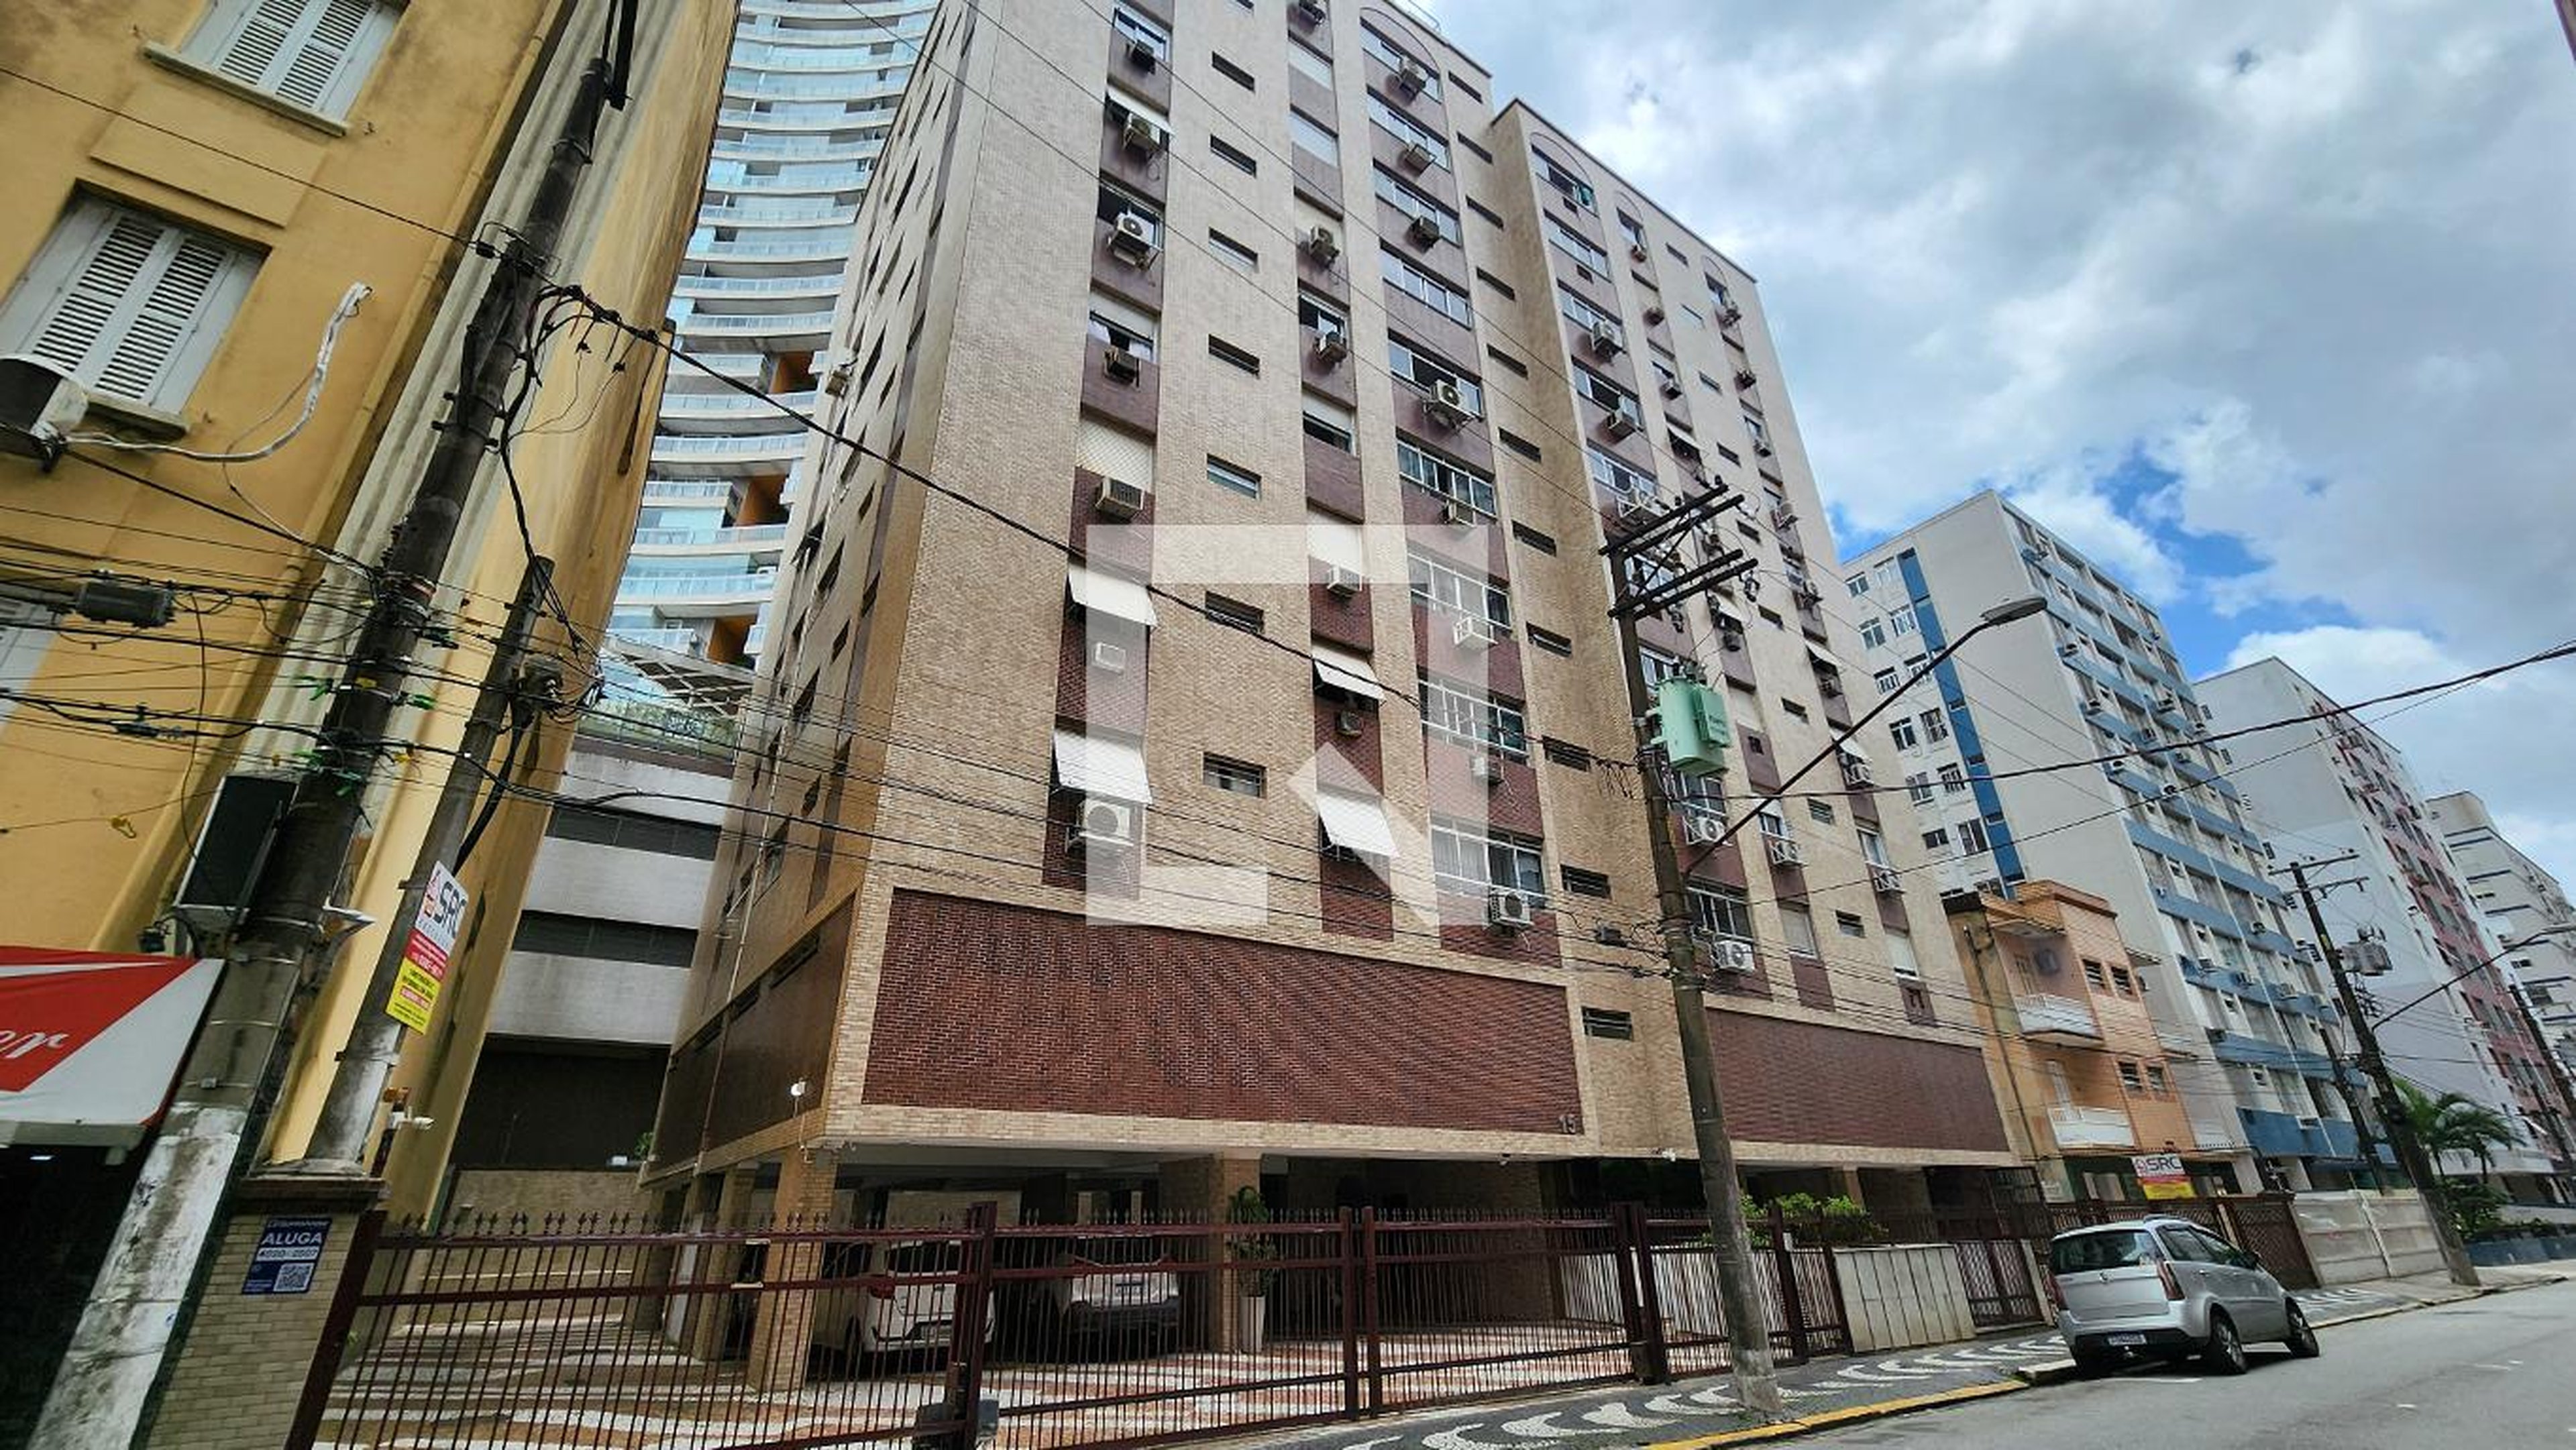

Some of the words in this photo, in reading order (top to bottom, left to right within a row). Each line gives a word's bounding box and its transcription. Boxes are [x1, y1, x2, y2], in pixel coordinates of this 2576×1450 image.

[433, 881, 468, 938] SRC
[2146, 1155, 2182, 1172] SRC
[260, 1232, 323, 1245] ALUGA
